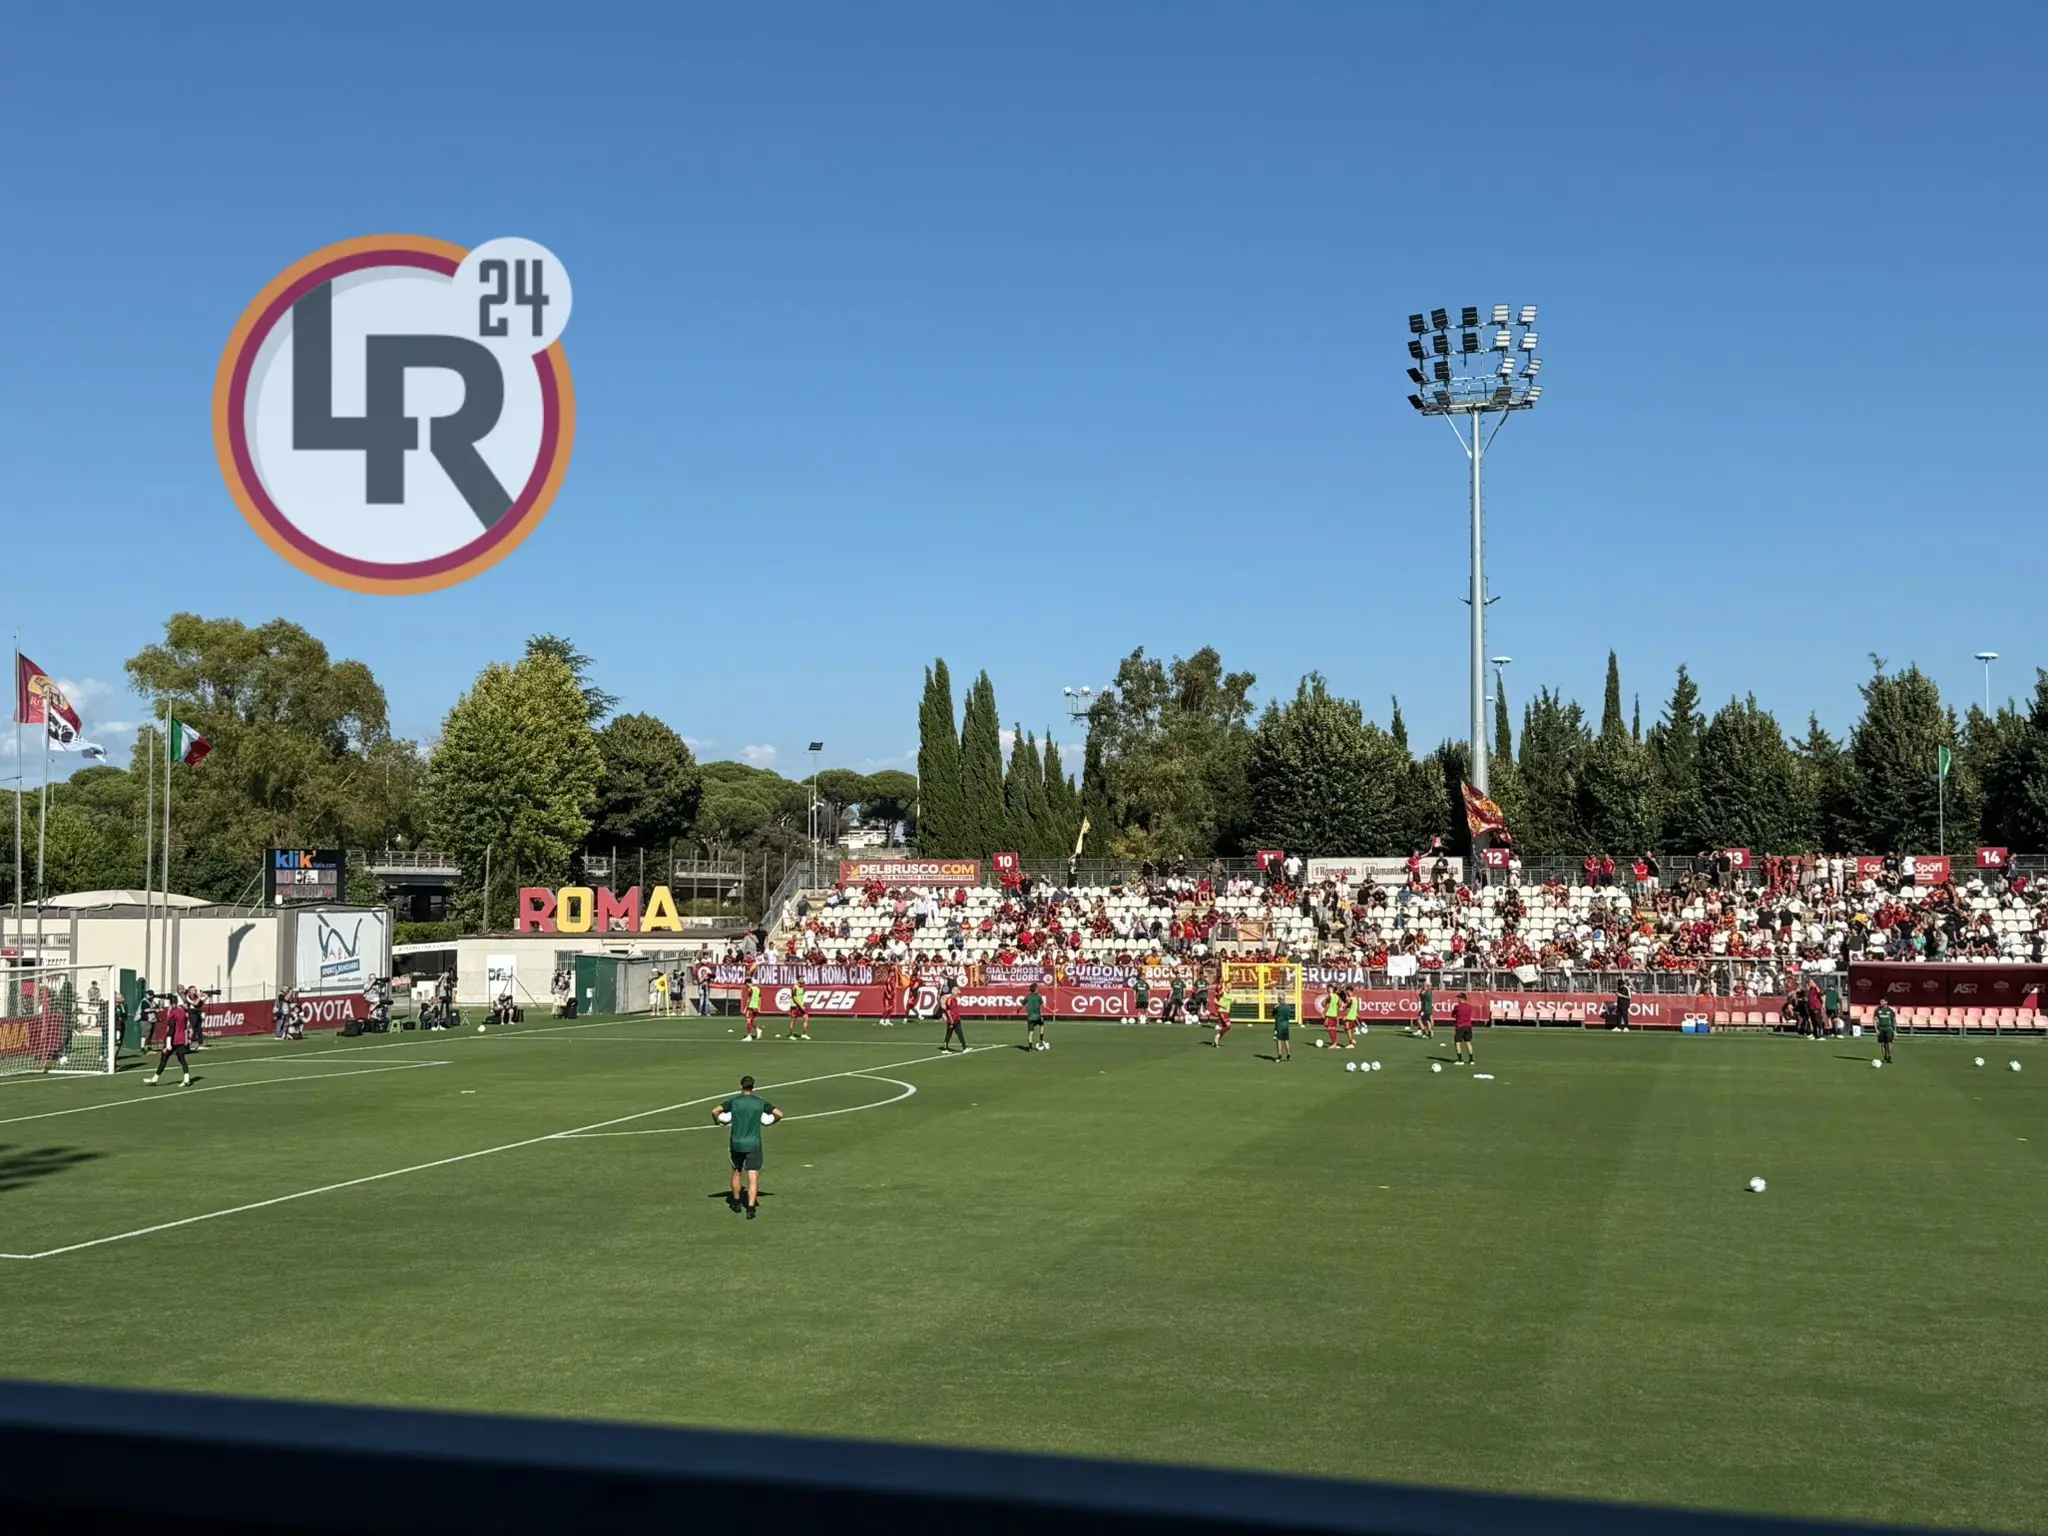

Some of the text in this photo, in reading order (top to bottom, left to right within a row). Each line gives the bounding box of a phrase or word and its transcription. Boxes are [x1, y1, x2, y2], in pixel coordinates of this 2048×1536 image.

[998, 856, 1012, 867] 10
[1262, 853, 1274, 866] 1
[1486, 852, 1503, 865] 12
[1982, 851, 2001, 864] 14
[859, 864, 975, 875] DELBRUSCO.COM
[1370, 866, 1405, 876] Romanist
[519, 885, 684, 933] ROMA
[822, 967, 848, 985] ROMA
[850, 967, 873, 983] CLUB
[1887, 982, 1911, 993] ASR
[1954, 983, 1978, 994] ASR
[1071, 991, 1129, 1014] enel
[301, 999, 354, 1023] OYOTA
